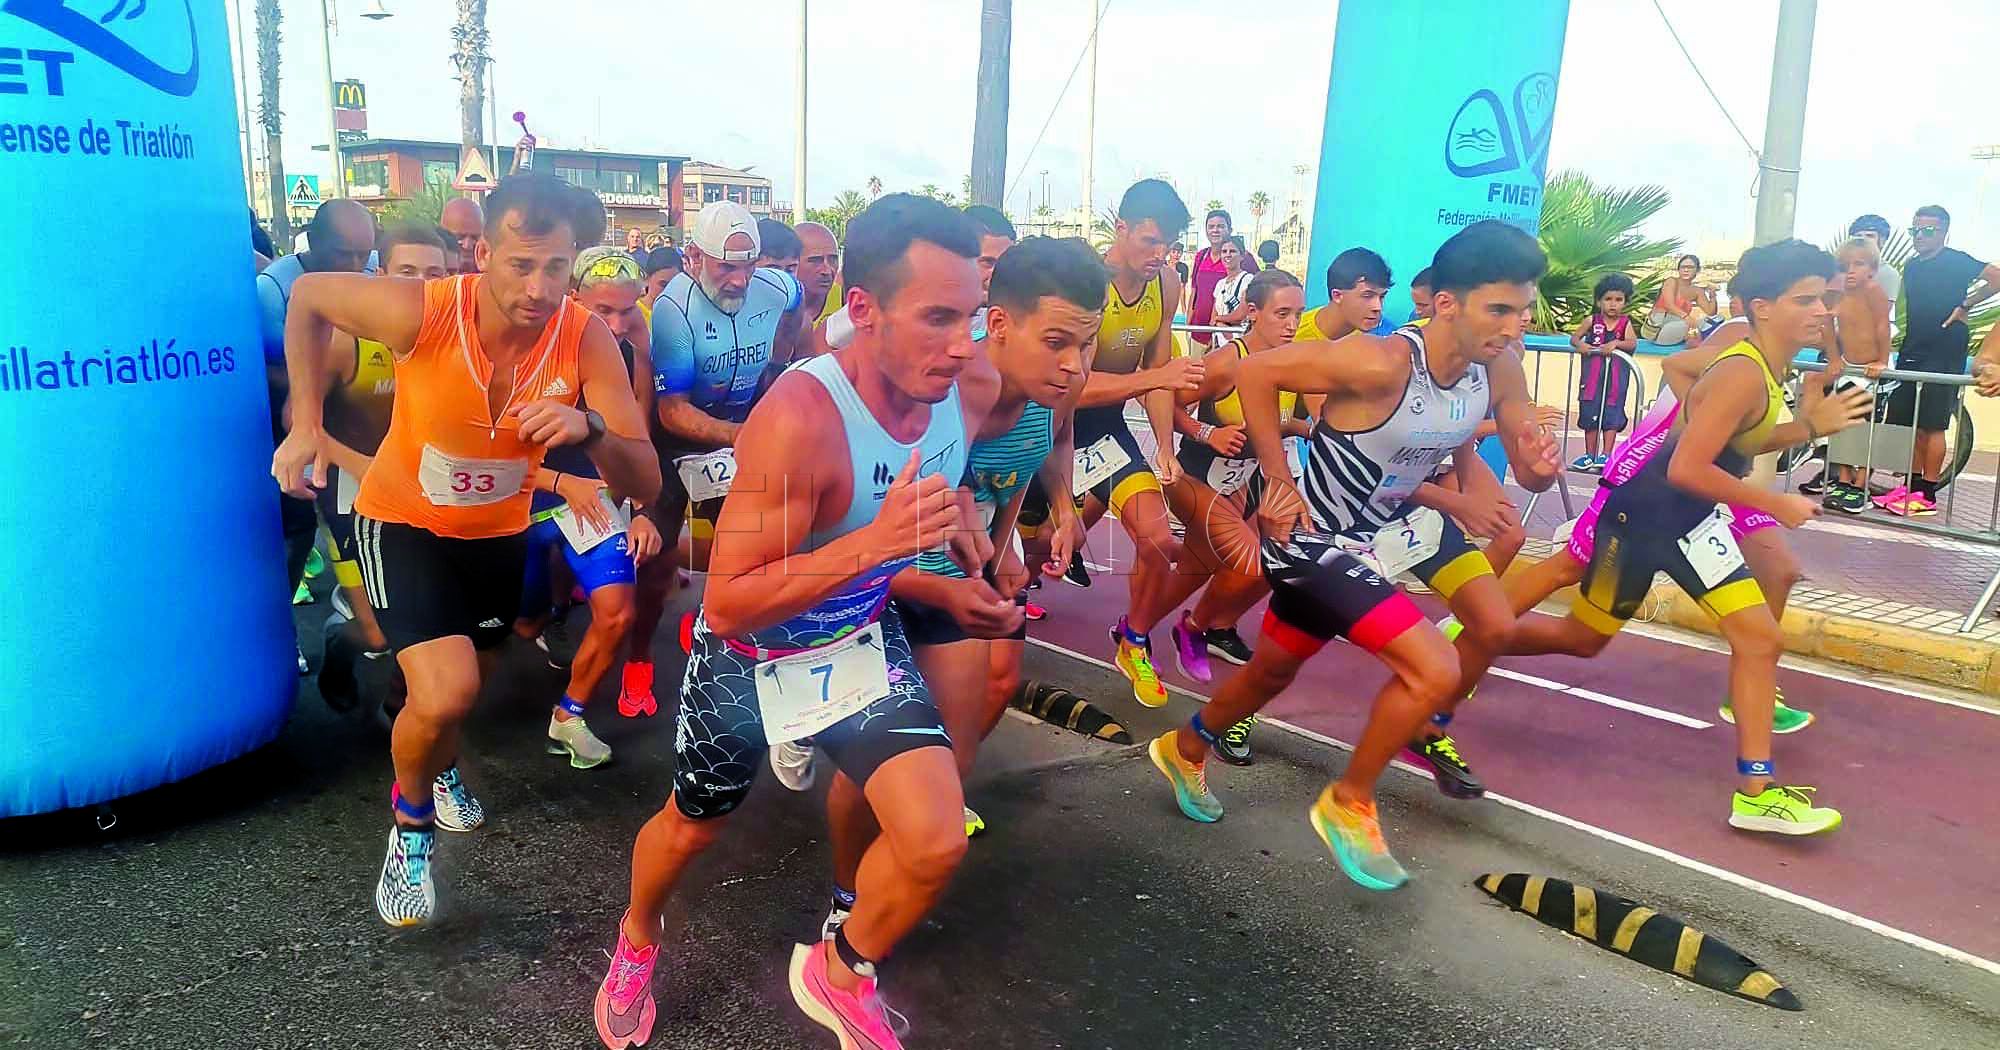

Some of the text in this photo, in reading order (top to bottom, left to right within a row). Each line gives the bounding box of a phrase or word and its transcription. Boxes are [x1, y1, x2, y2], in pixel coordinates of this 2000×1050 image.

[79, 119, 111, 155] de
[116, 119, 194, 160] Triatlón
[1487, 182, 1539, 207] FMET
[702, 462, 731, 484] 12
[1079, 451, 1105, 474] 21
[451, 472, 496, 493] 33
[1401, 529, 1421, 549] 2
[1708, 536, 1728, 556] 3
[810, 663, 834, 703] 7
